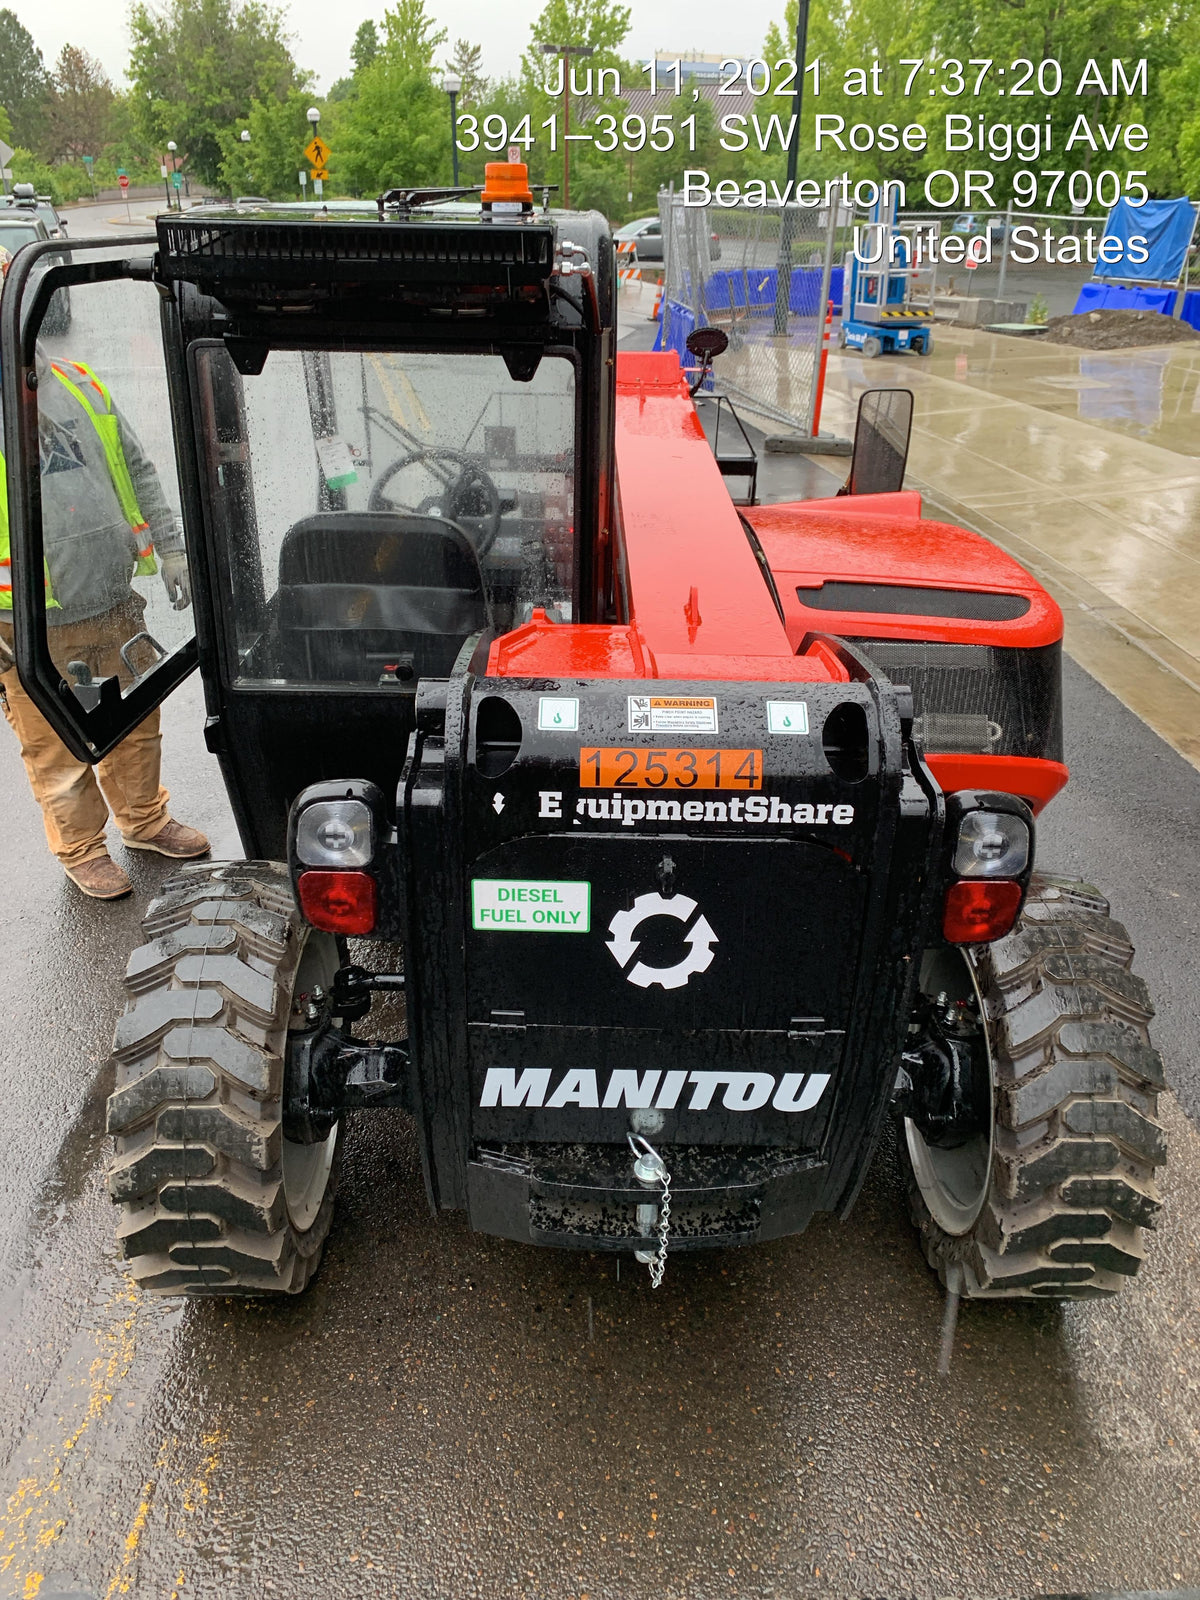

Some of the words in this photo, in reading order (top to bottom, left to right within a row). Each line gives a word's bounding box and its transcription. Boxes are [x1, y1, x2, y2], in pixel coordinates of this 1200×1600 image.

[586, 750, 759, 788] 125314
[498, 888, 564, 903] DIESEL
[480, 909, 527, 923] FUEL
[532, 910, 581, 924] ONLY
[480, 1068, 831, 1112] MANITOU
